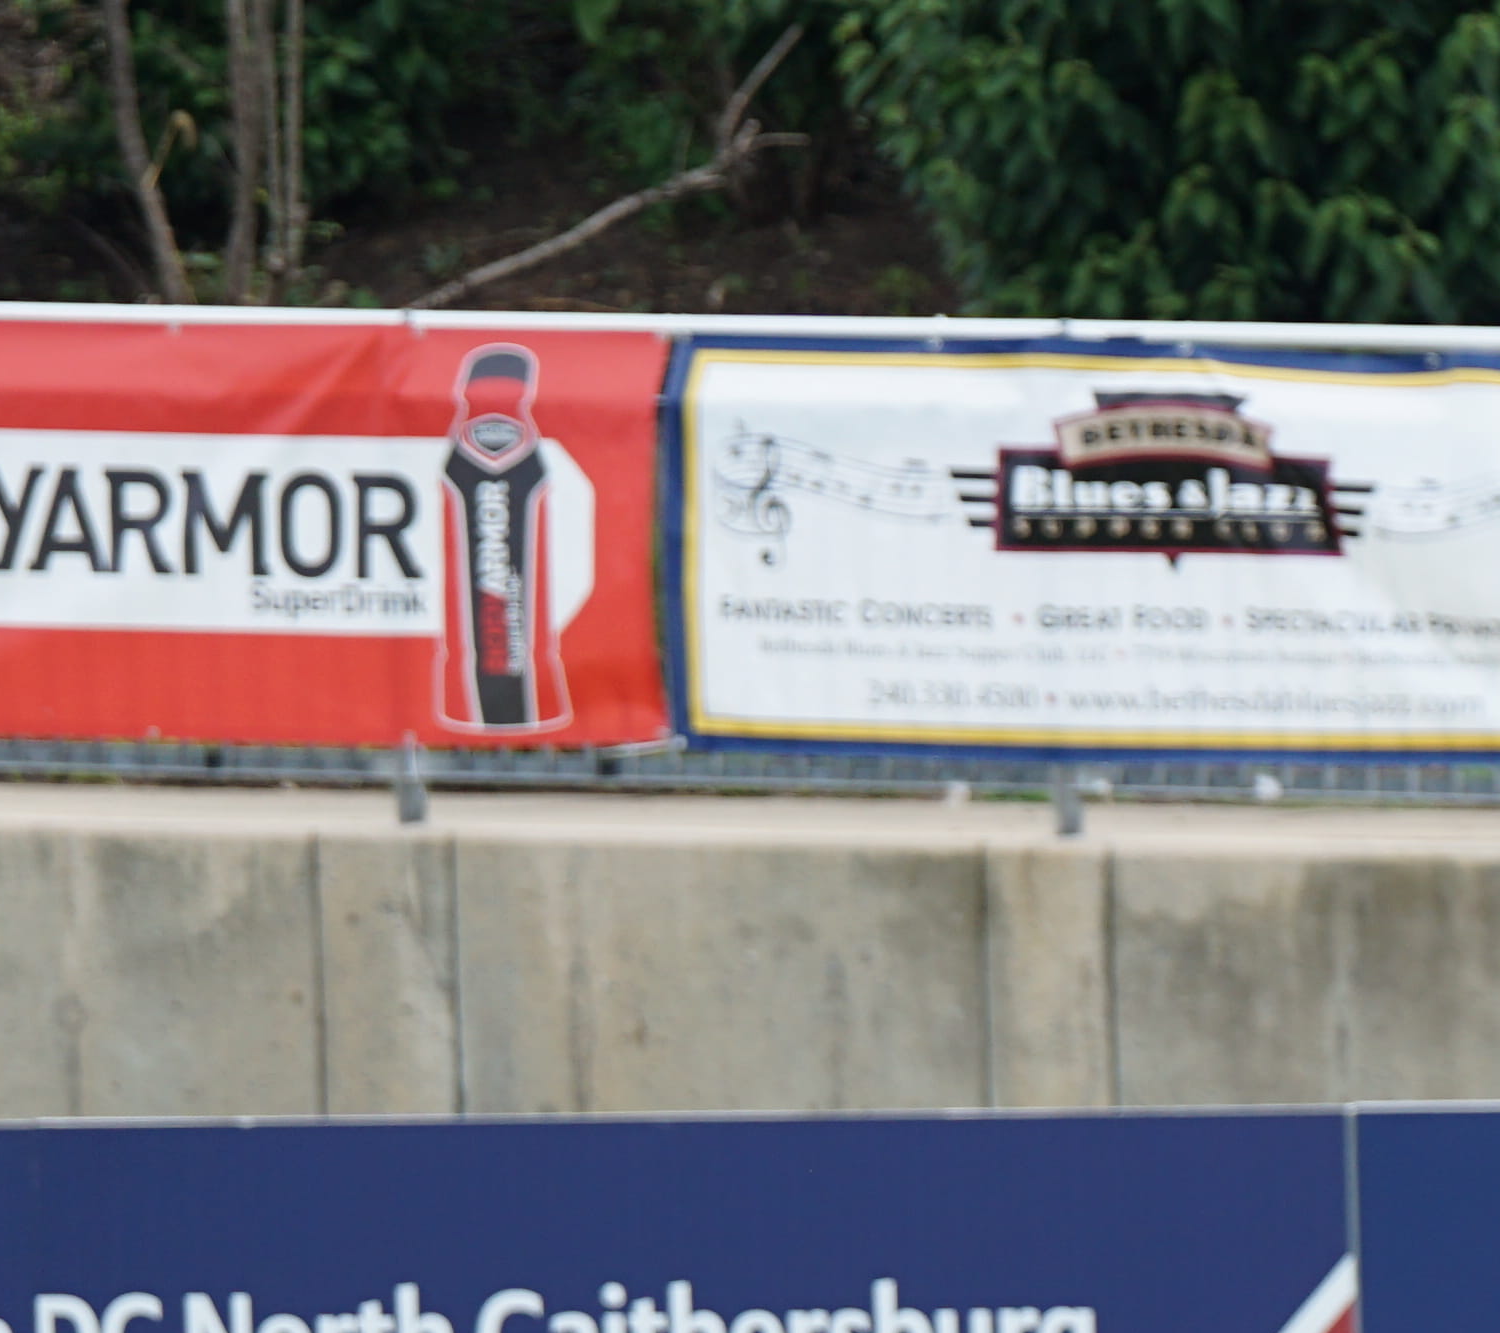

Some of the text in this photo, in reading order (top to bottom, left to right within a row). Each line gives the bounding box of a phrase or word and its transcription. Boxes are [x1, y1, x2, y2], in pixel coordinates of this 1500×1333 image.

[1010, 464, 1172, 512] Blues
[251, 582, 428, 620] SuperDrink
[1133, 604, 1209, 632] FOOD
